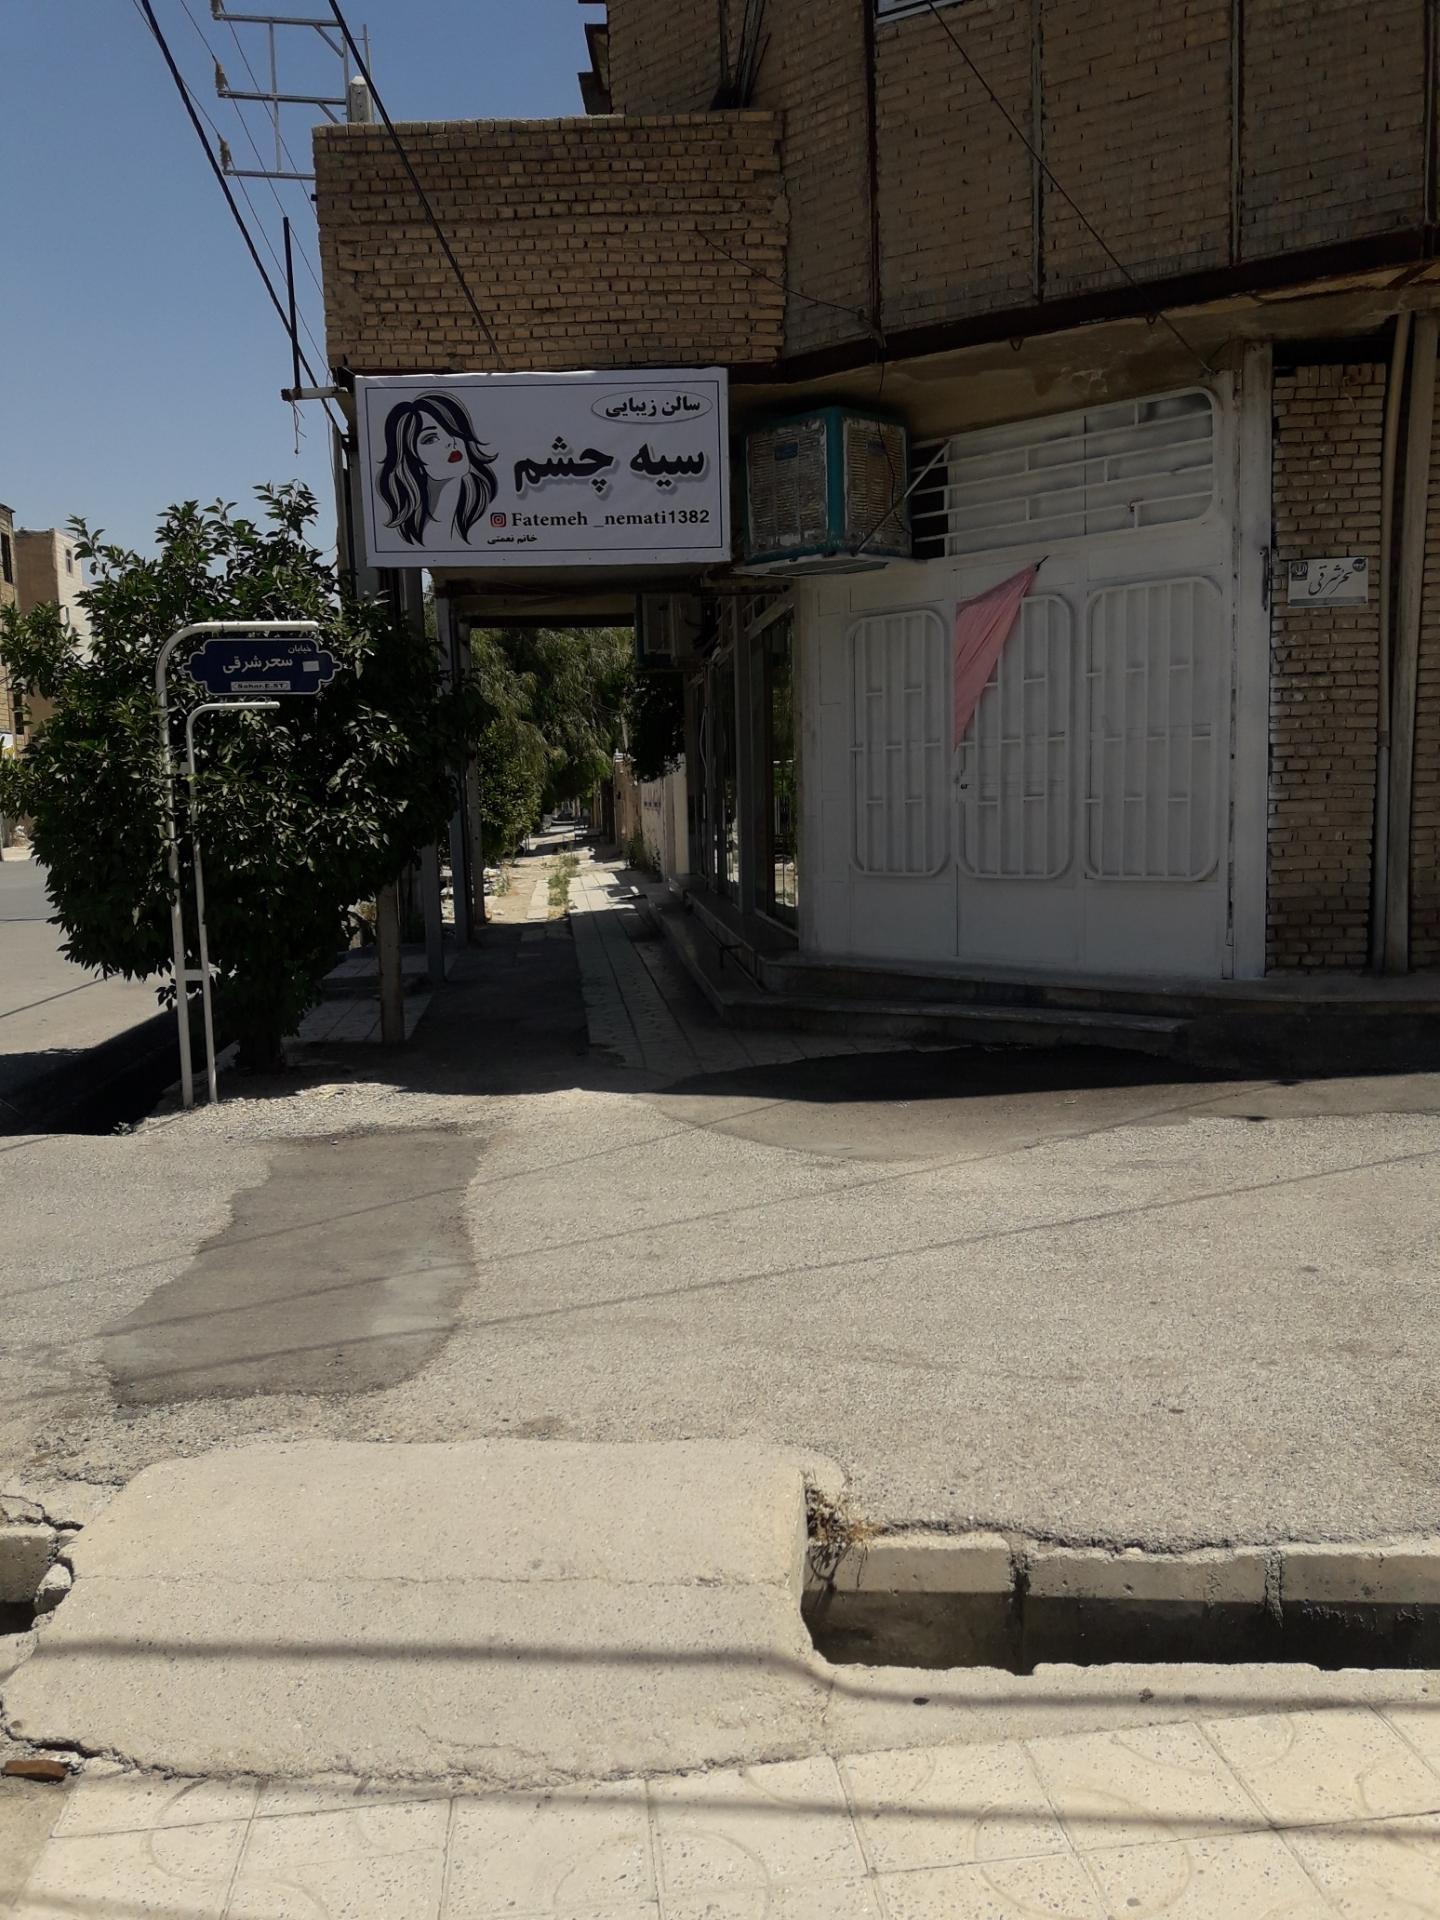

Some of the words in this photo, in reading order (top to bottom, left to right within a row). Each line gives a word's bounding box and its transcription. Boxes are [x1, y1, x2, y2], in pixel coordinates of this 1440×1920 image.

[605, 397, 657, 417] زیبایی
[661, 396, 700, 416] سالن
[514, 436, 614, 493] چشم
[630, 443, 704, 488] سیه
[511, 511, 588, 527] Fatemeh
[487, 534, 515, 545] نعمتی
[517, 534, 537, 544] خانم
[287, 644, 312, 655] خیابان
[222, 655, 262, 674] شرقی
[262, 657, 293, 672] سحر
